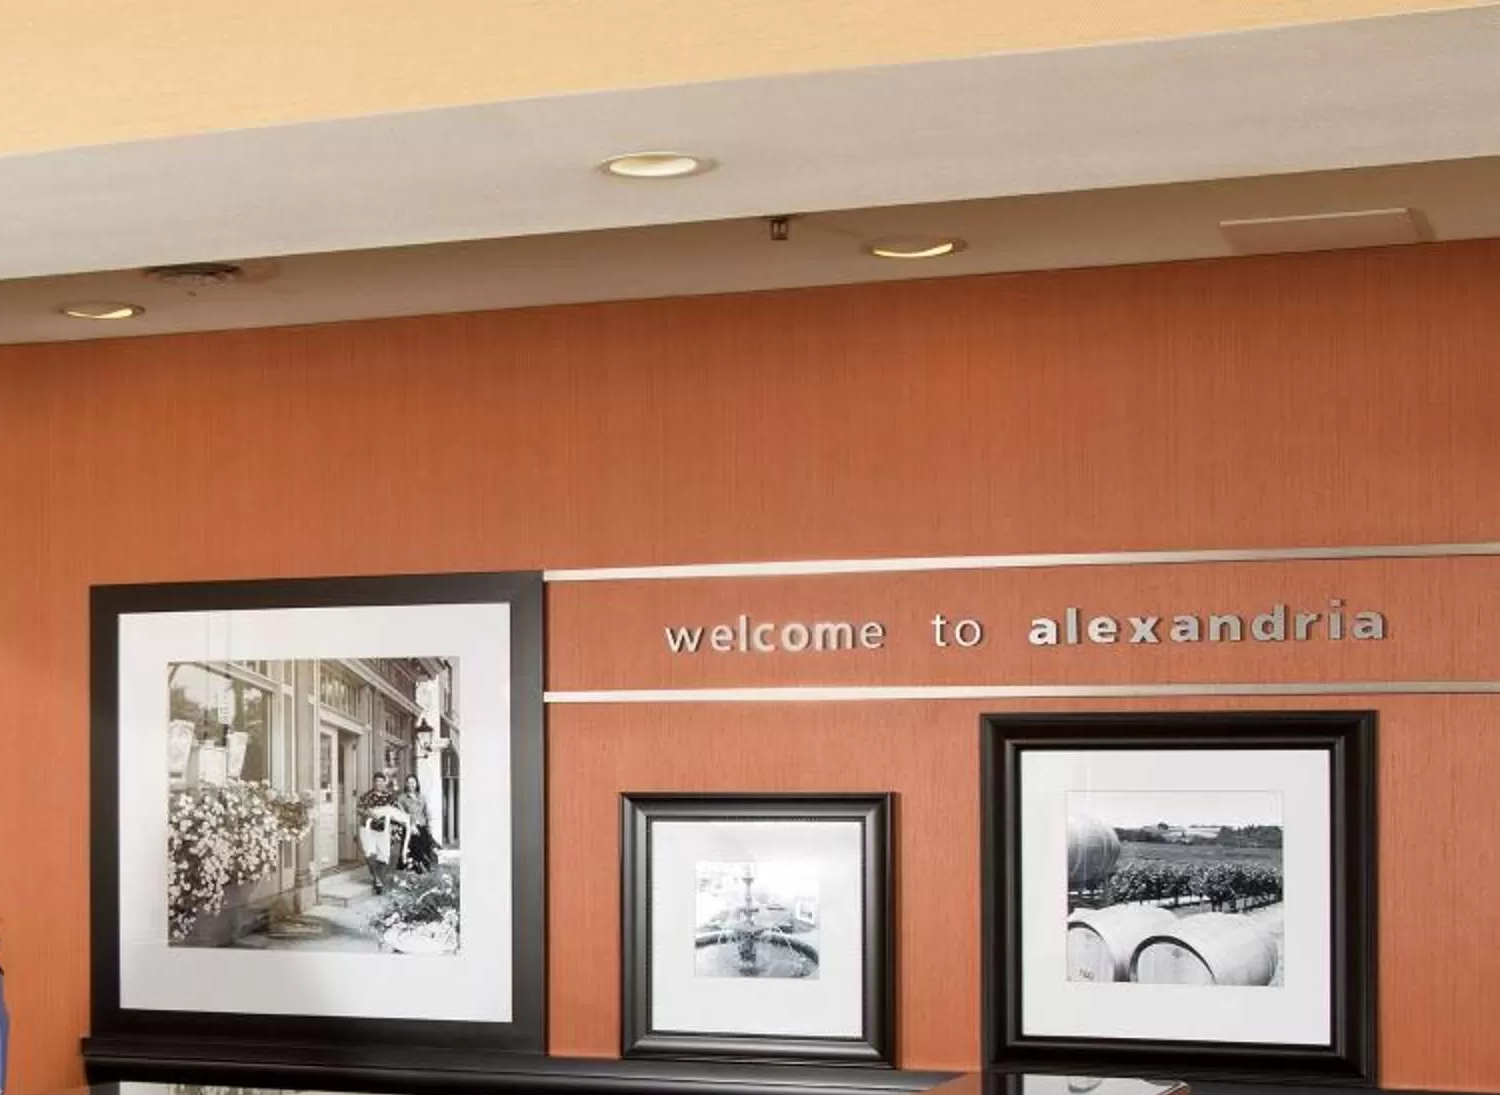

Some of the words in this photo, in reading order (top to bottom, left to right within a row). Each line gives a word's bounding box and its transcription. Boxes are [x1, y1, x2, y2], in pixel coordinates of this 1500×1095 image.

[664, 614, 886, 653] welcome
[930, 613, 983, 648] to
[1027, 599, 1386, 645] alexandria
